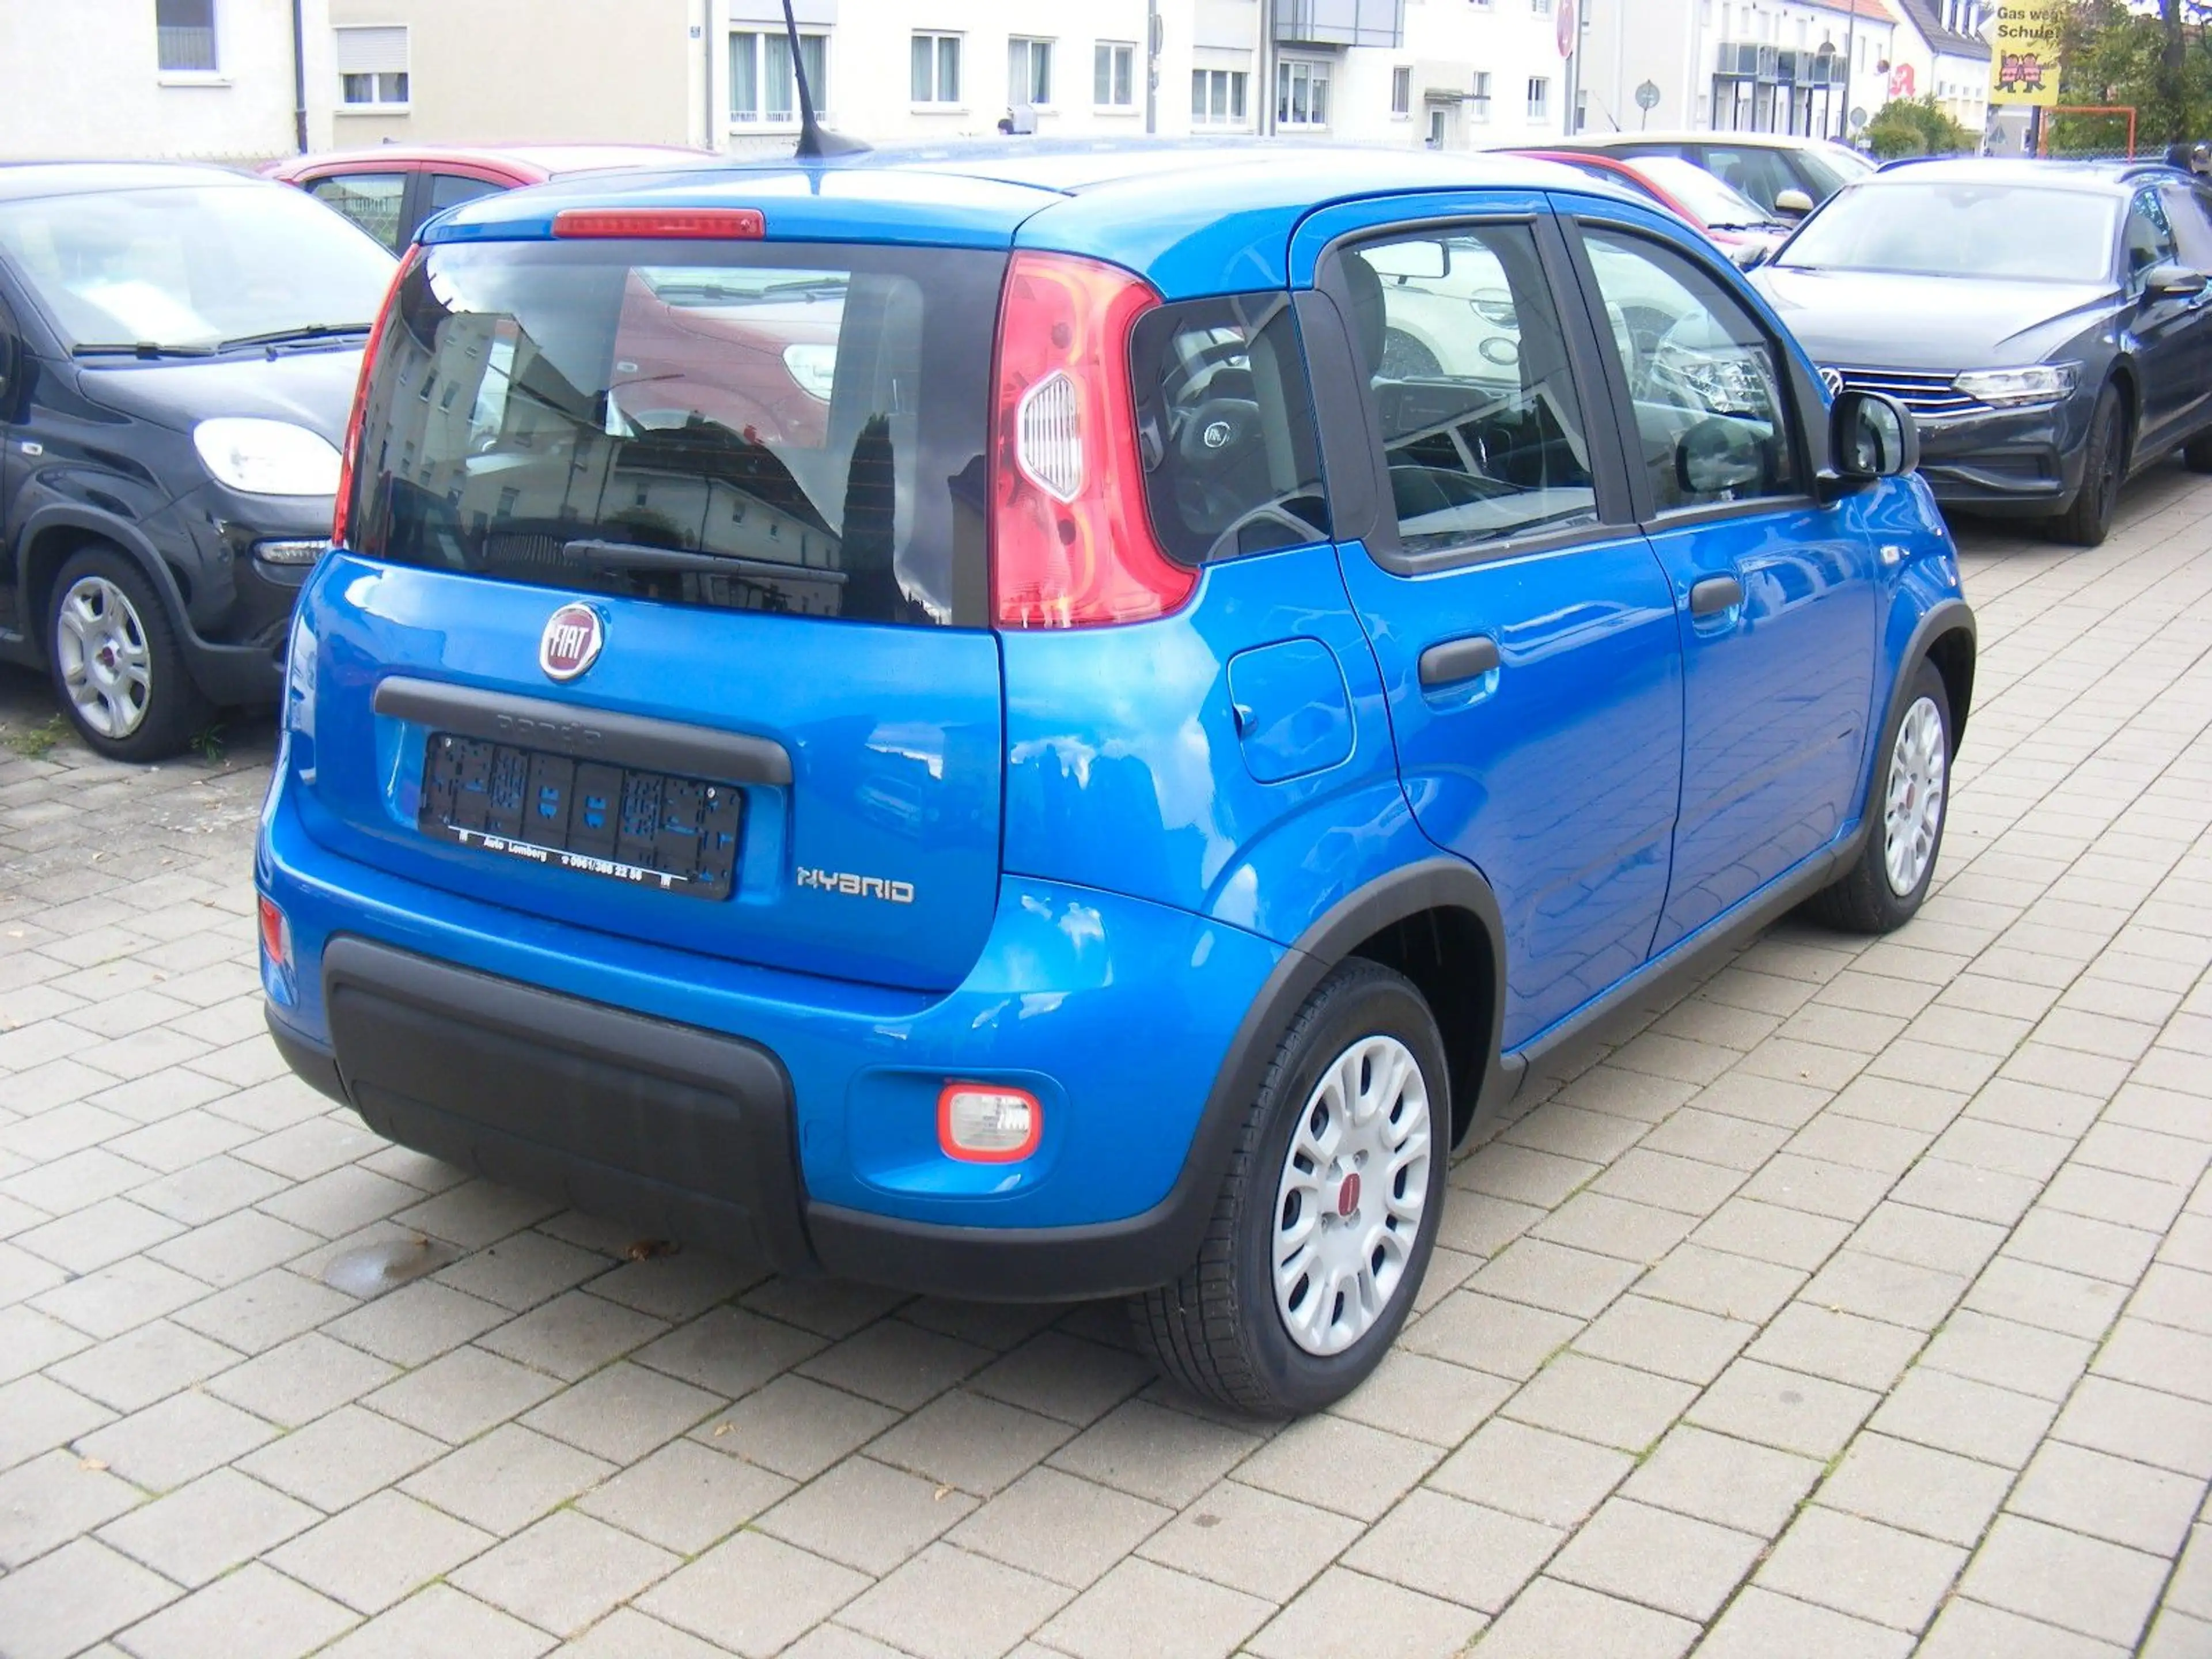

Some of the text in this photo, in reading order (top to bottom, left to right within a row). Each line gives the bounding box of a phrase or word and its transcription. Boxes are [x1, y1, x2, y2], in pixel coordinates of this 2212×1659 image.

[1997, 7, 2063, 24] Gas weg
[550, 623, 590, 659] FIAT
[797, 866, 915, 903] HYBRID
